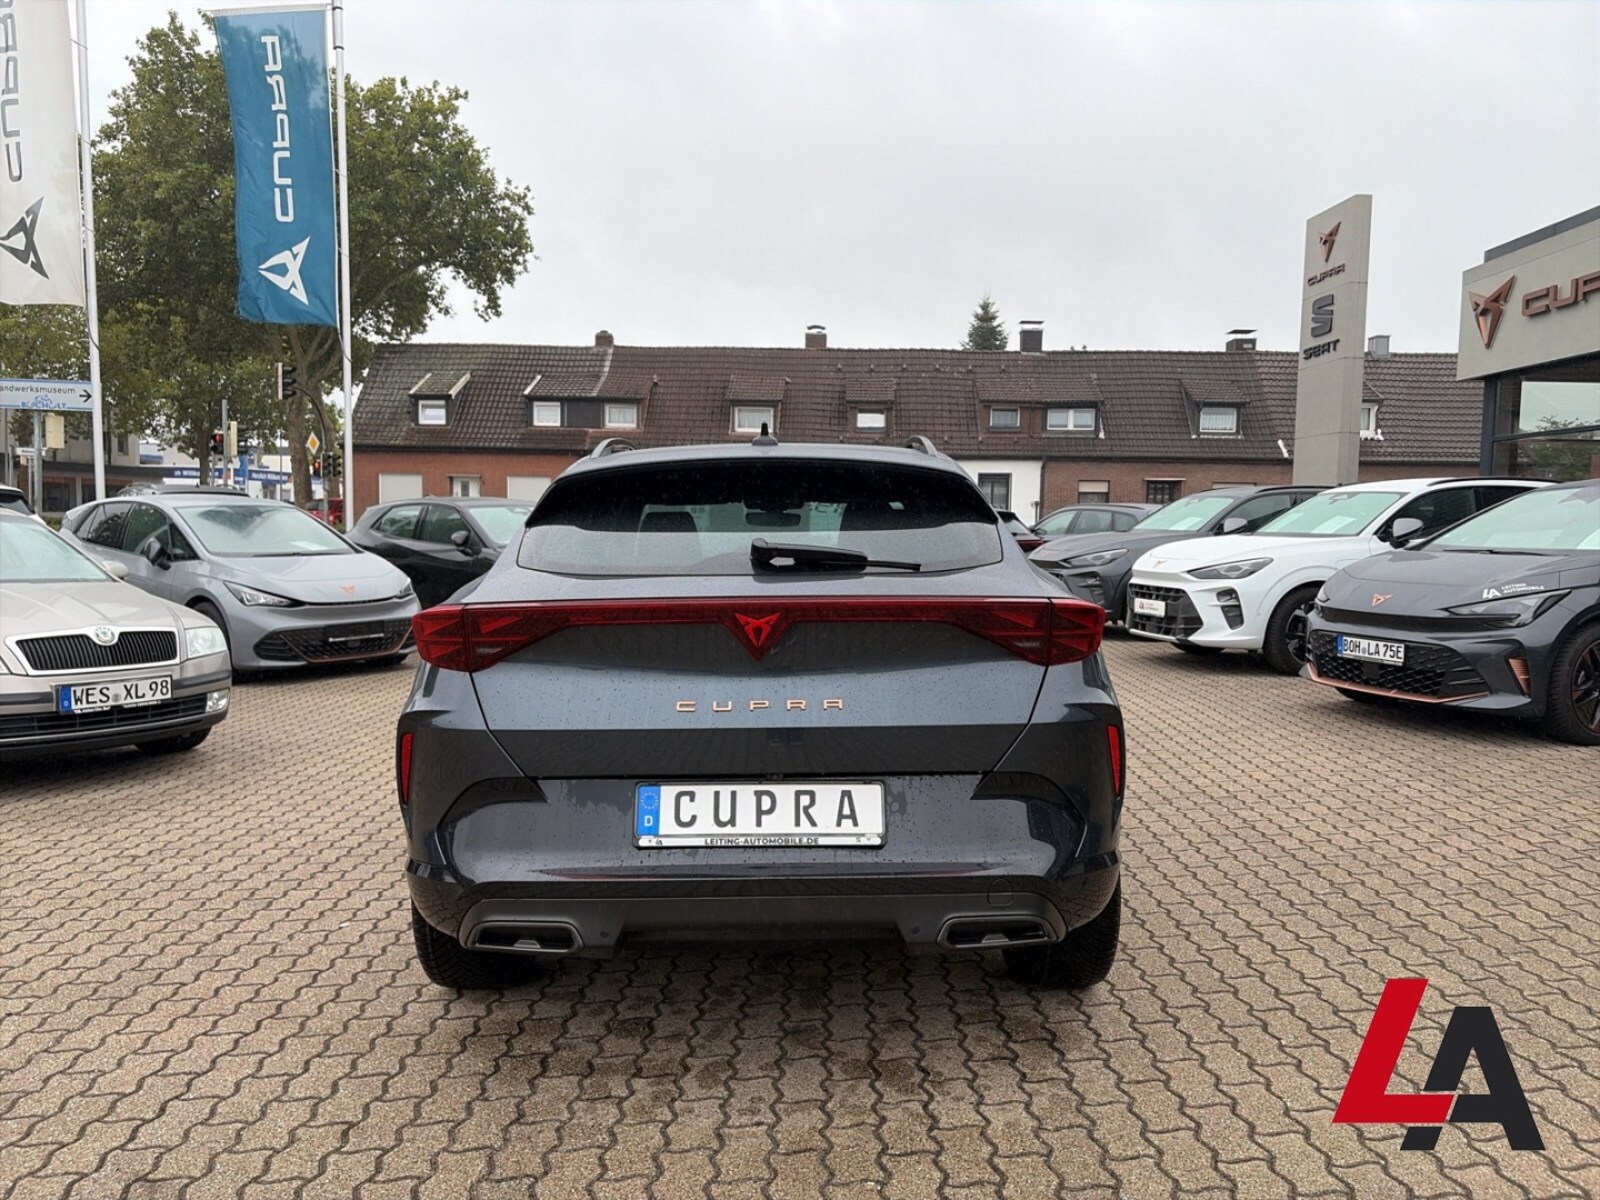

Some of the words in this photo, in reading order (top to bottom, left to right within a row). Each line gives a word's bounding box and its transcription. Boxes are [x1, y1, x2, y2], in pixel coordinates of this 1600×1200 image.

[1307, 263, 1346, 287] CUPRA
[1303, 338, 1340, 360] SEAT
[1343, 639, 1361, 654] BOH
[1382, 644, 1403, 660] 75E
[73, 686, 111, 706] WES
[123, 683, 146, 701] XL
[149, 680, 170, 697] 98
[675, 698, 844, 713] CUPRA
[643, 814, 654, 827] D
[673, 789, 860, 829] CUPRA
[704, 837, 820, 846] LEITING-AUTOMOBILE.DE
